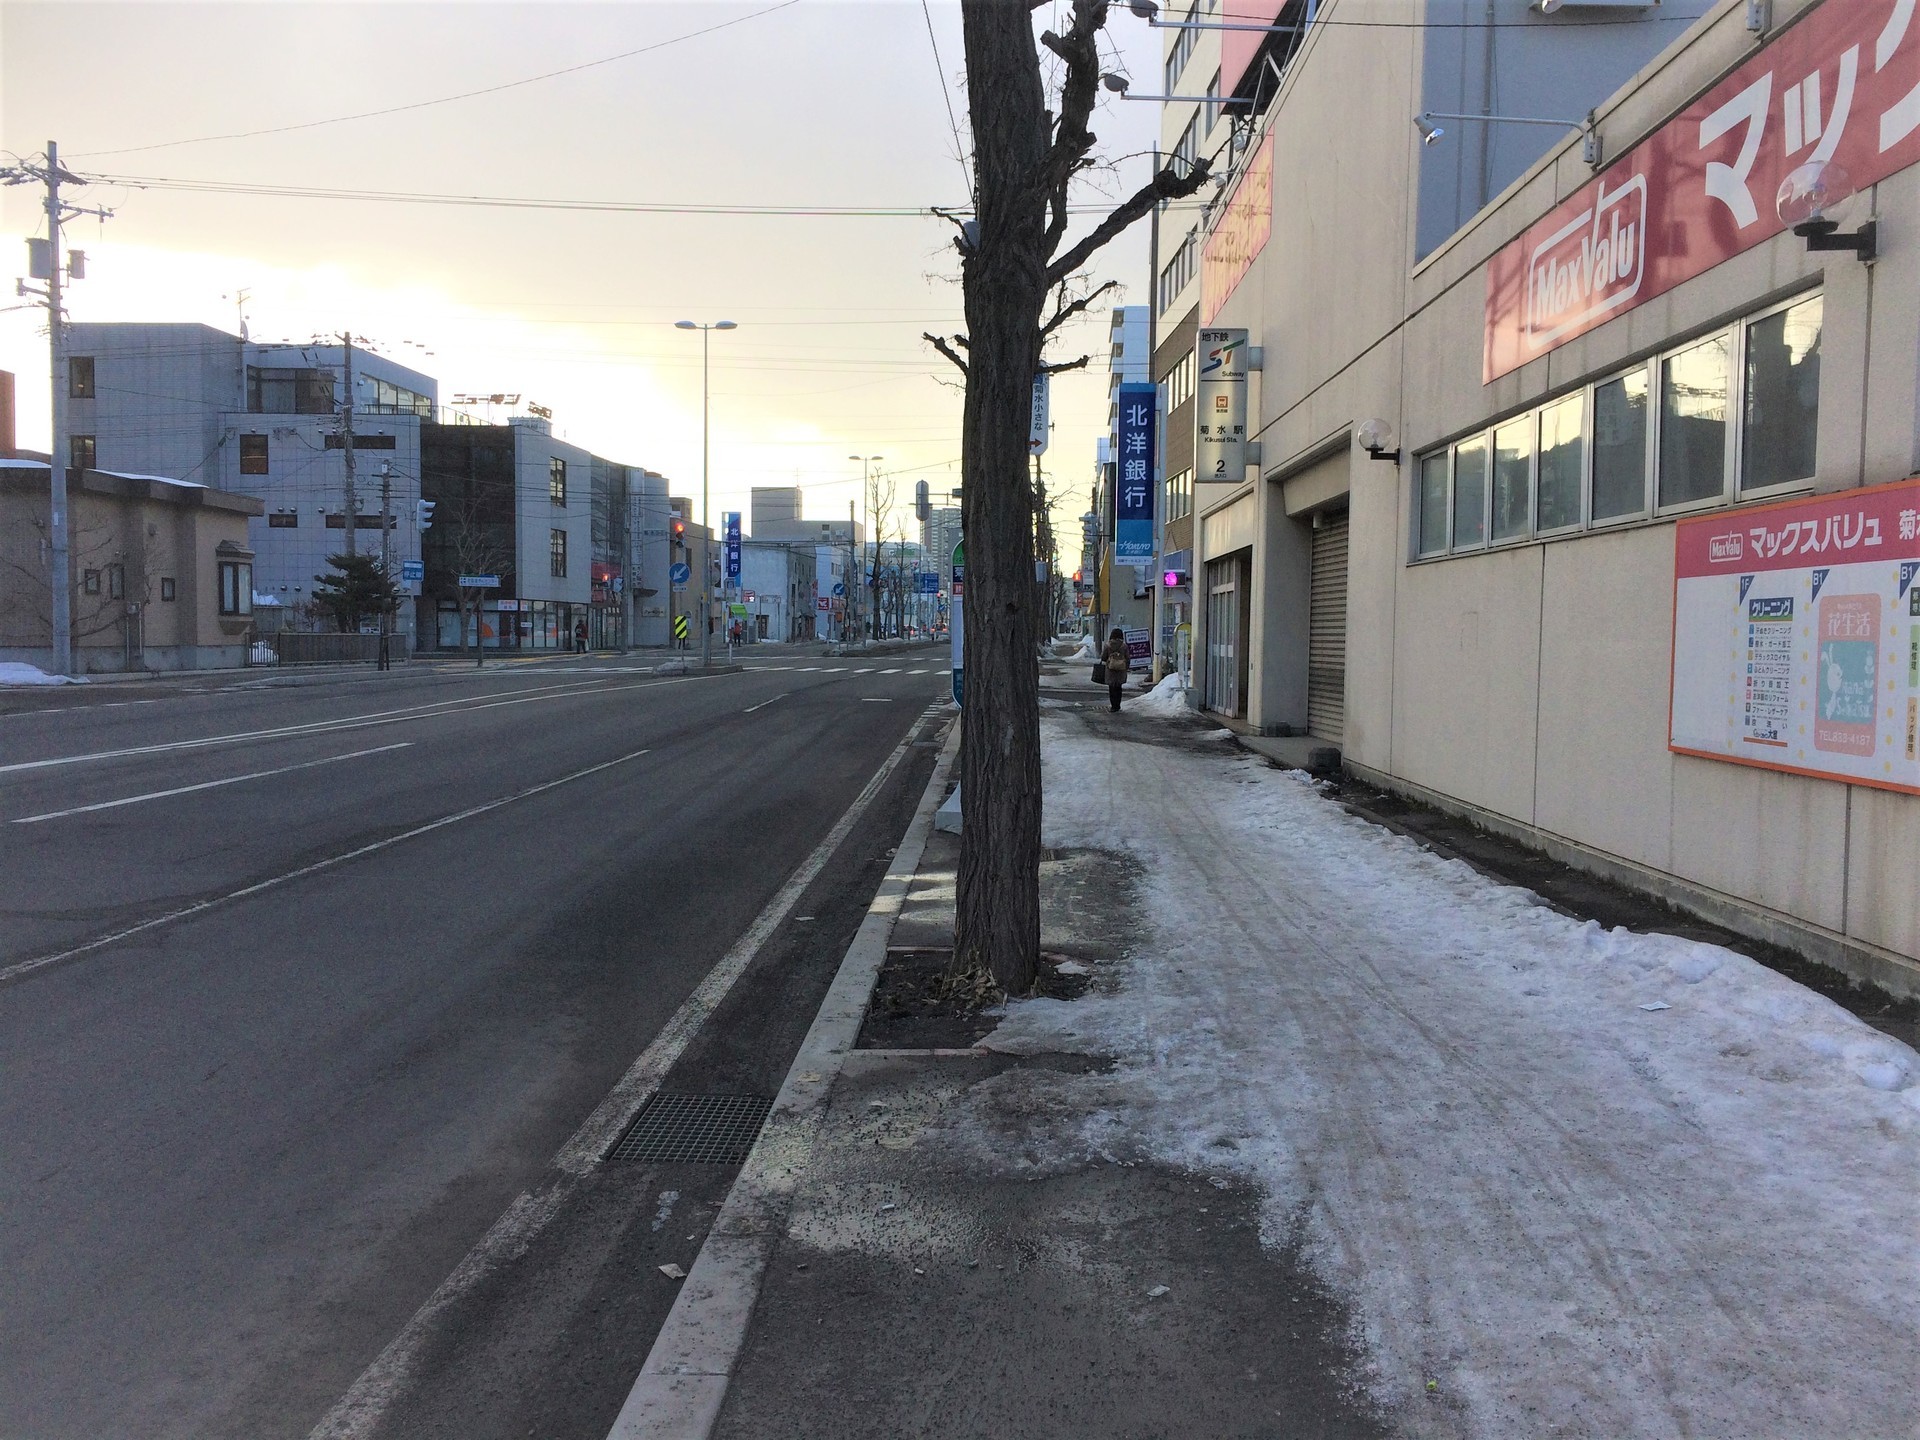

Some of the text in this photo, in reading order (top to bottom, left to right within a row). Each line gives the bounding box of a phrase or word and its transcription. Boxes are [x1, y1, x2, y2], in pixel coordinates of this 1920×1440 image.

[1536, 181, 1635, 324] MaxValu
[1202, 333, 1229, 341] 地下鉄
[1125, 404, 1148, 508] 北洋銀行
[1216, 460, 1225, 472] 2
[1750, 509, 1920, 558] マックスバリュ 菊
[730, 528, 739, 572] 北洋銀行
[1712, 531, 1741, 557] MaxValu
[1813, 572, 1823, 586] B1
[1901, 566, 1912, 580] B1
[1741, 578, 1750, 591] 1F
[1752, 600, 1791, 617] クリーニング
